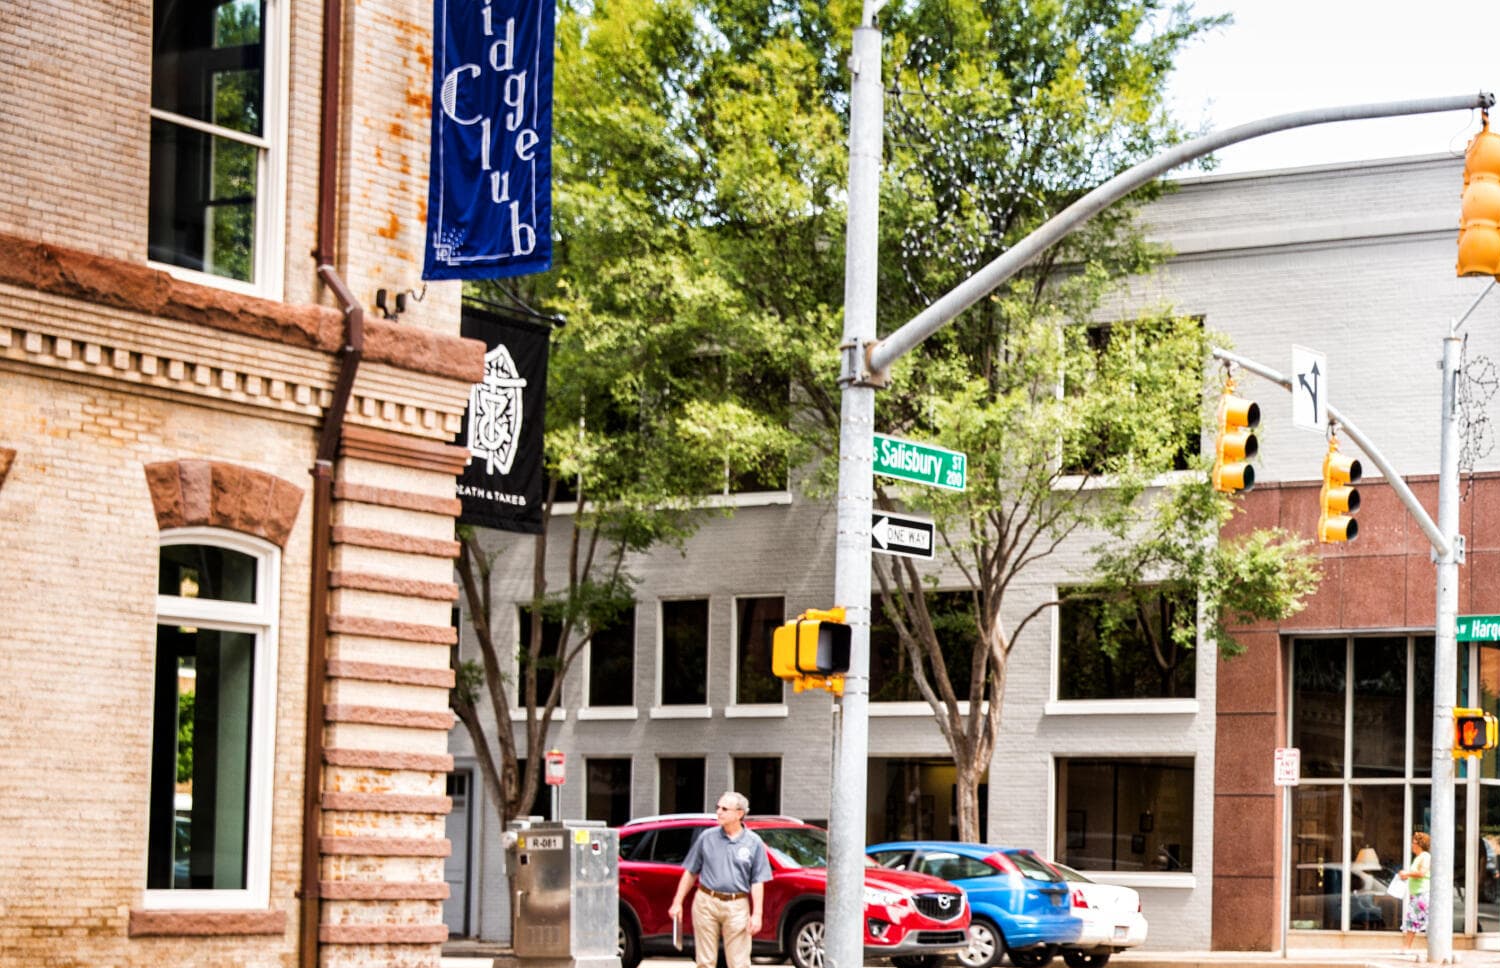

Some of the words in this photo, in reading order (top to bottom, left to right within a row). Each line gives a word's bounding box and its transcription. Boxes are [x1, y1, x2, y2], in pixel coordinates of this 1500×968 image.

[440, 63, 537, 257] Club
[880, 439, 943, 484] Salisbury
[952, 455, 963, 471] ST
[946, 470, 963, 487] 200
[908, 530, 928, 545] WAY
